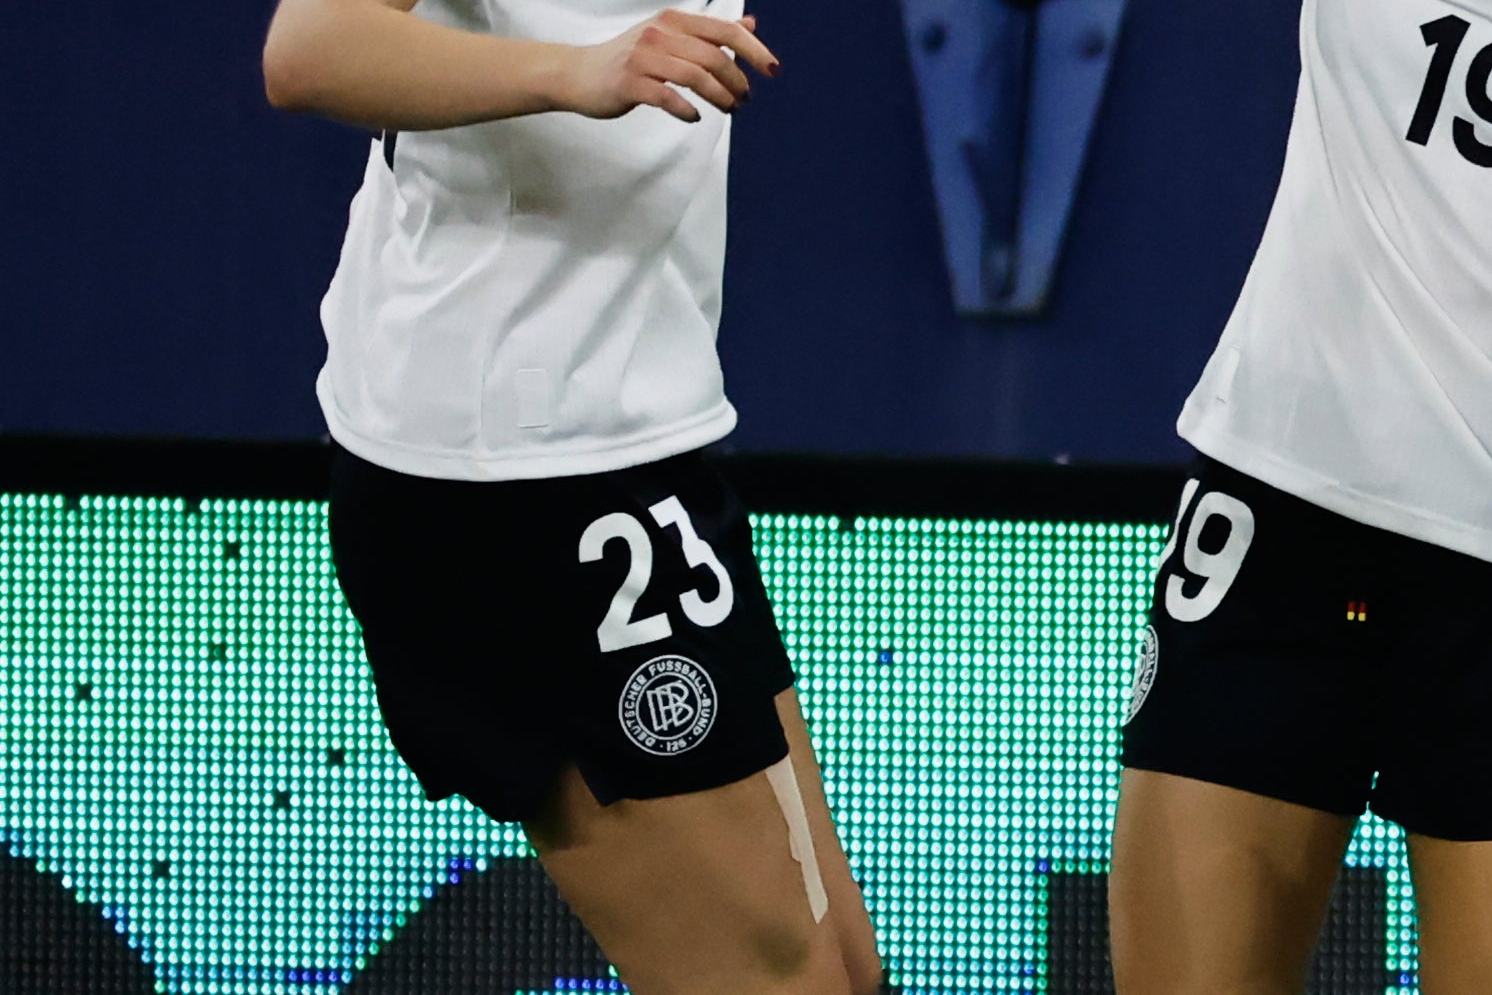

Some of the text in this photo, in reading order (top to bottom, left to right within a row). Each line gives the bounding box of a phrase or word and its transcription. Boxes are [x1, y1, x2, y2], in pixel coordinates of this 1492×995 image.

[578, 494, 734, 654] 23
[624, 673, 657, 748] DEUTSCHER
[666, 738, 687, 753] 125
